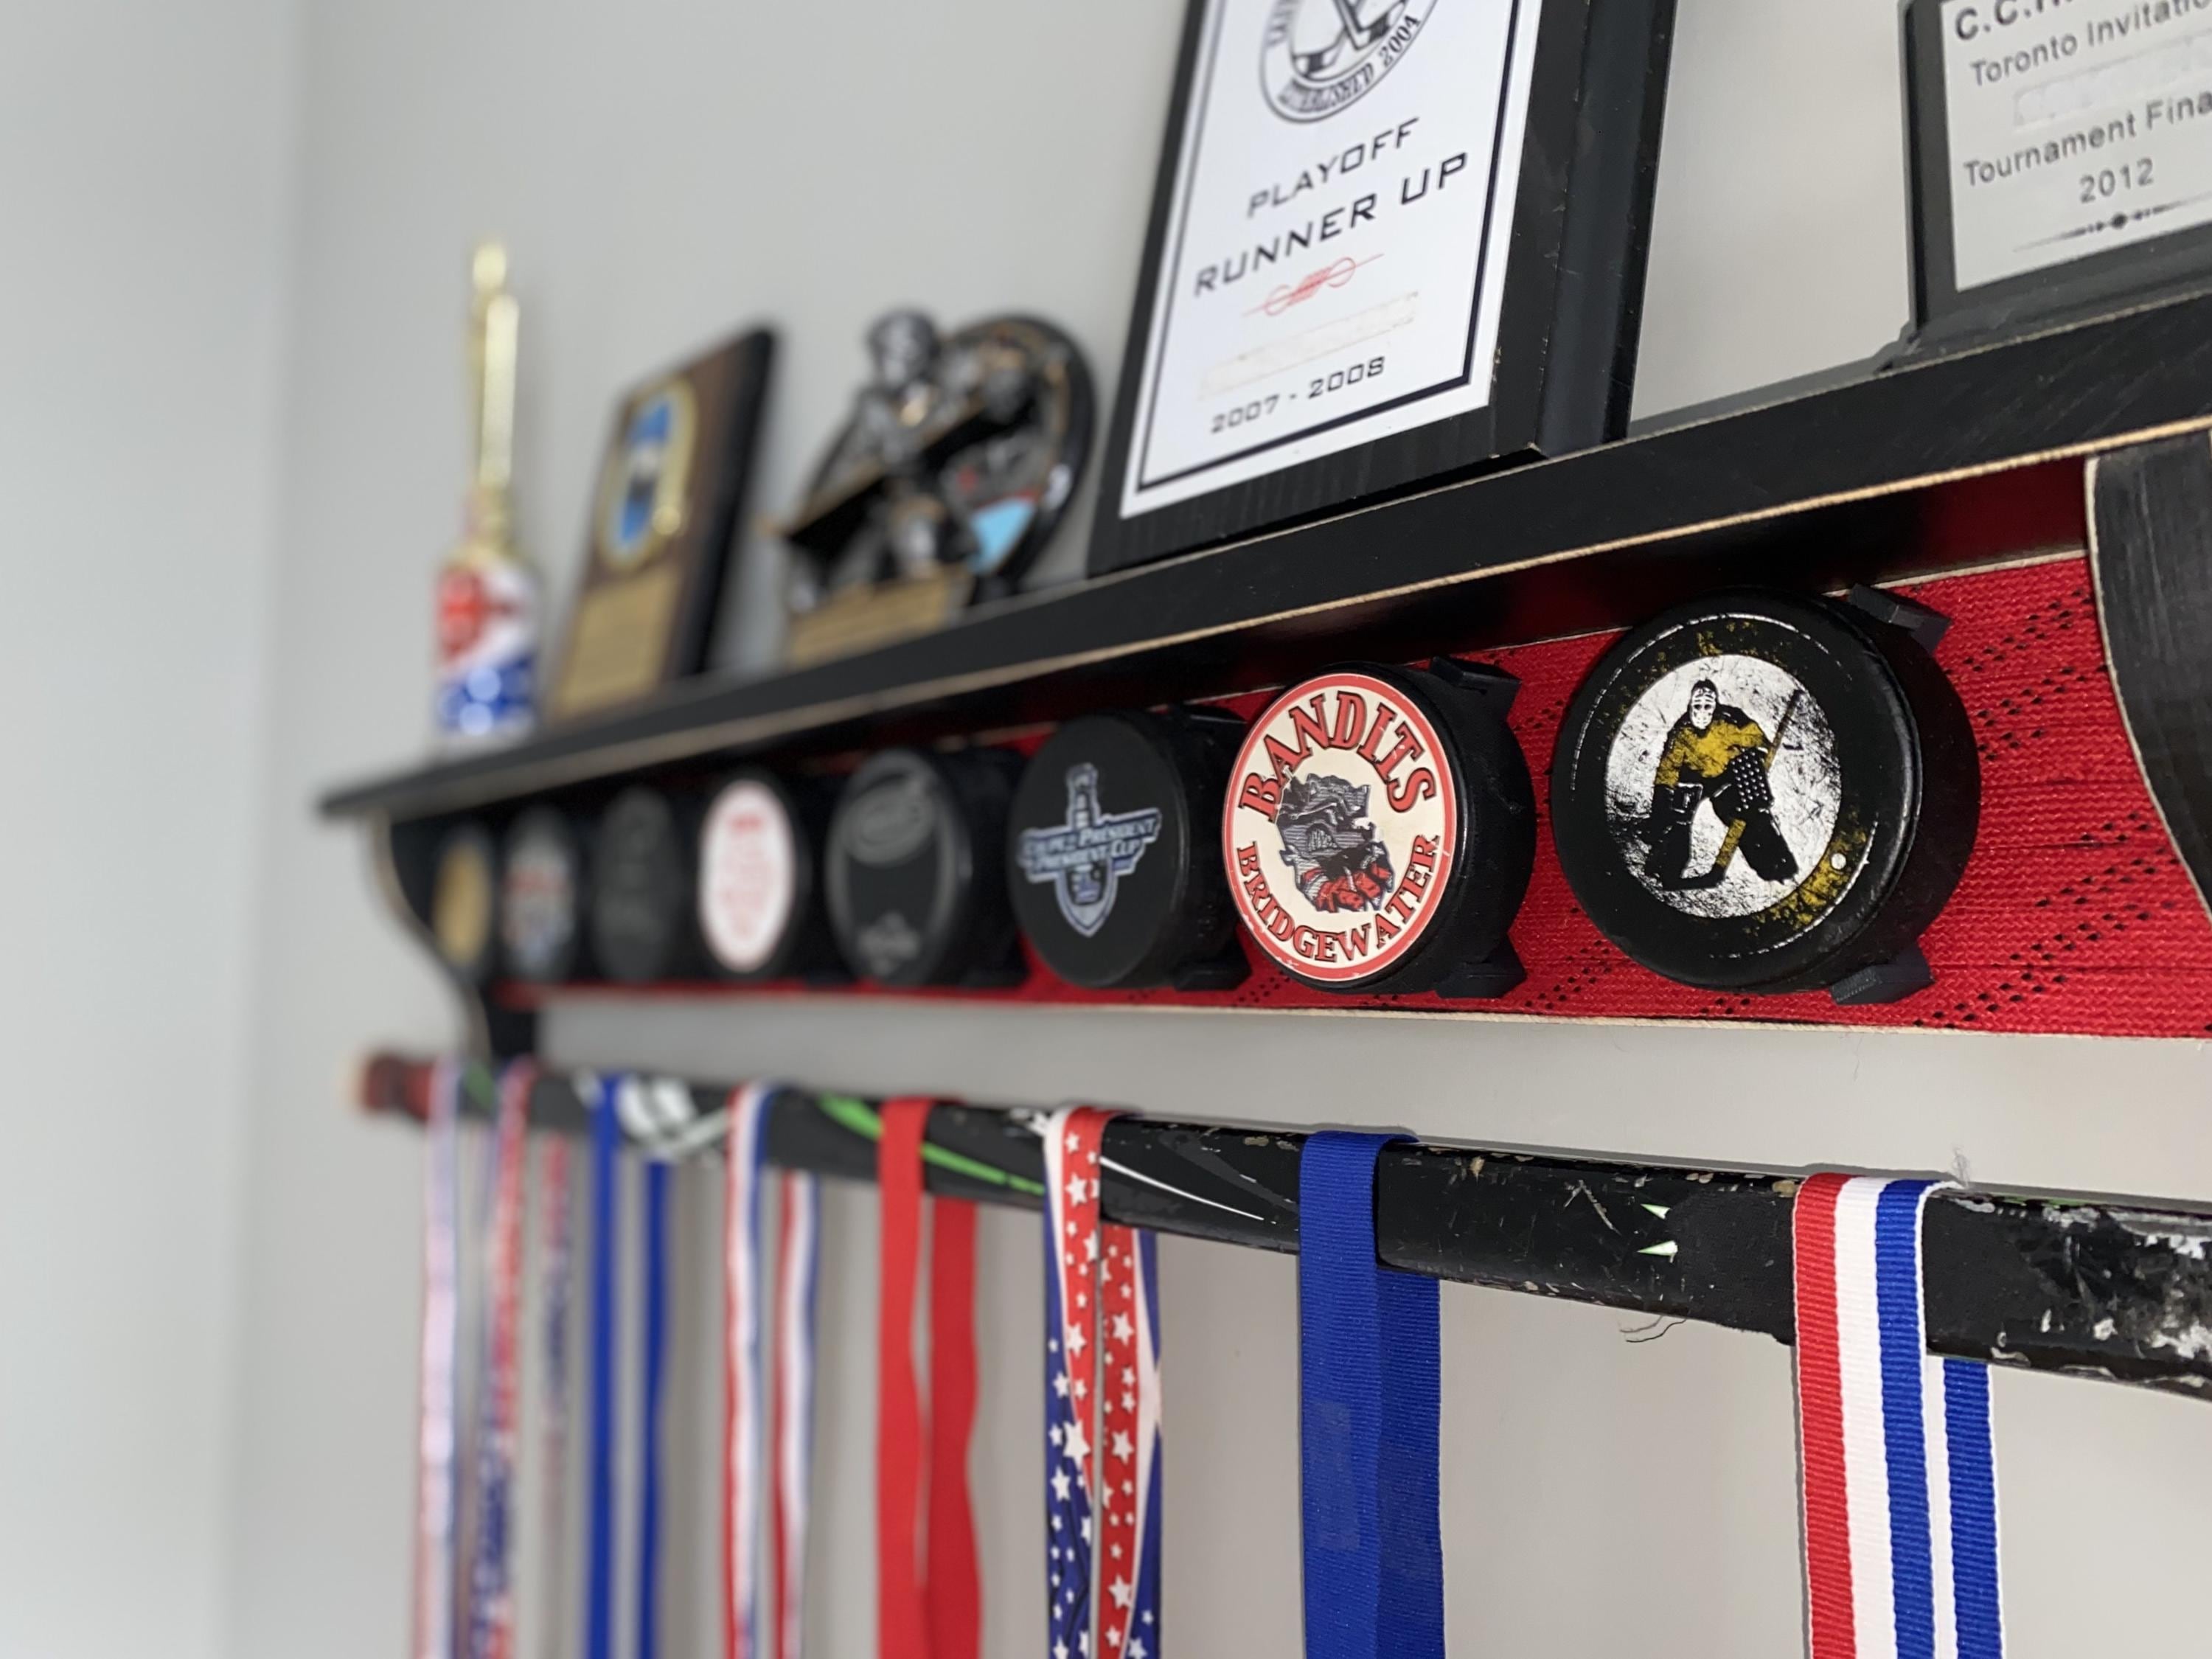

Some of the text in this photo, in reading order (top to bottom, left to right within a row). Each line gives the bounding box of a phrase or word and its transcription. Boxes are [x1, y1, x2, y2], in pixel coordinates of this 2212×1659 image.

[1278, 15, 1422, 113] LISHED 2004
[1970, 33, 2078, 86] Toronto
[1247, 116, 1420, 218] PLAYOFF
[1963, 111, 2137, 187] Tournament
[2079, 157, 2154, 204] 2012
[1194, 152, 1467, 297] RUNNER UP
[1211, 394, 1280, 434] 2007
[1308, 355, 1385, 399] 2008
[1239, 690, 1437, 824] BANDITS
[1237, 835, 1440, 962] BRIDGEWATER
